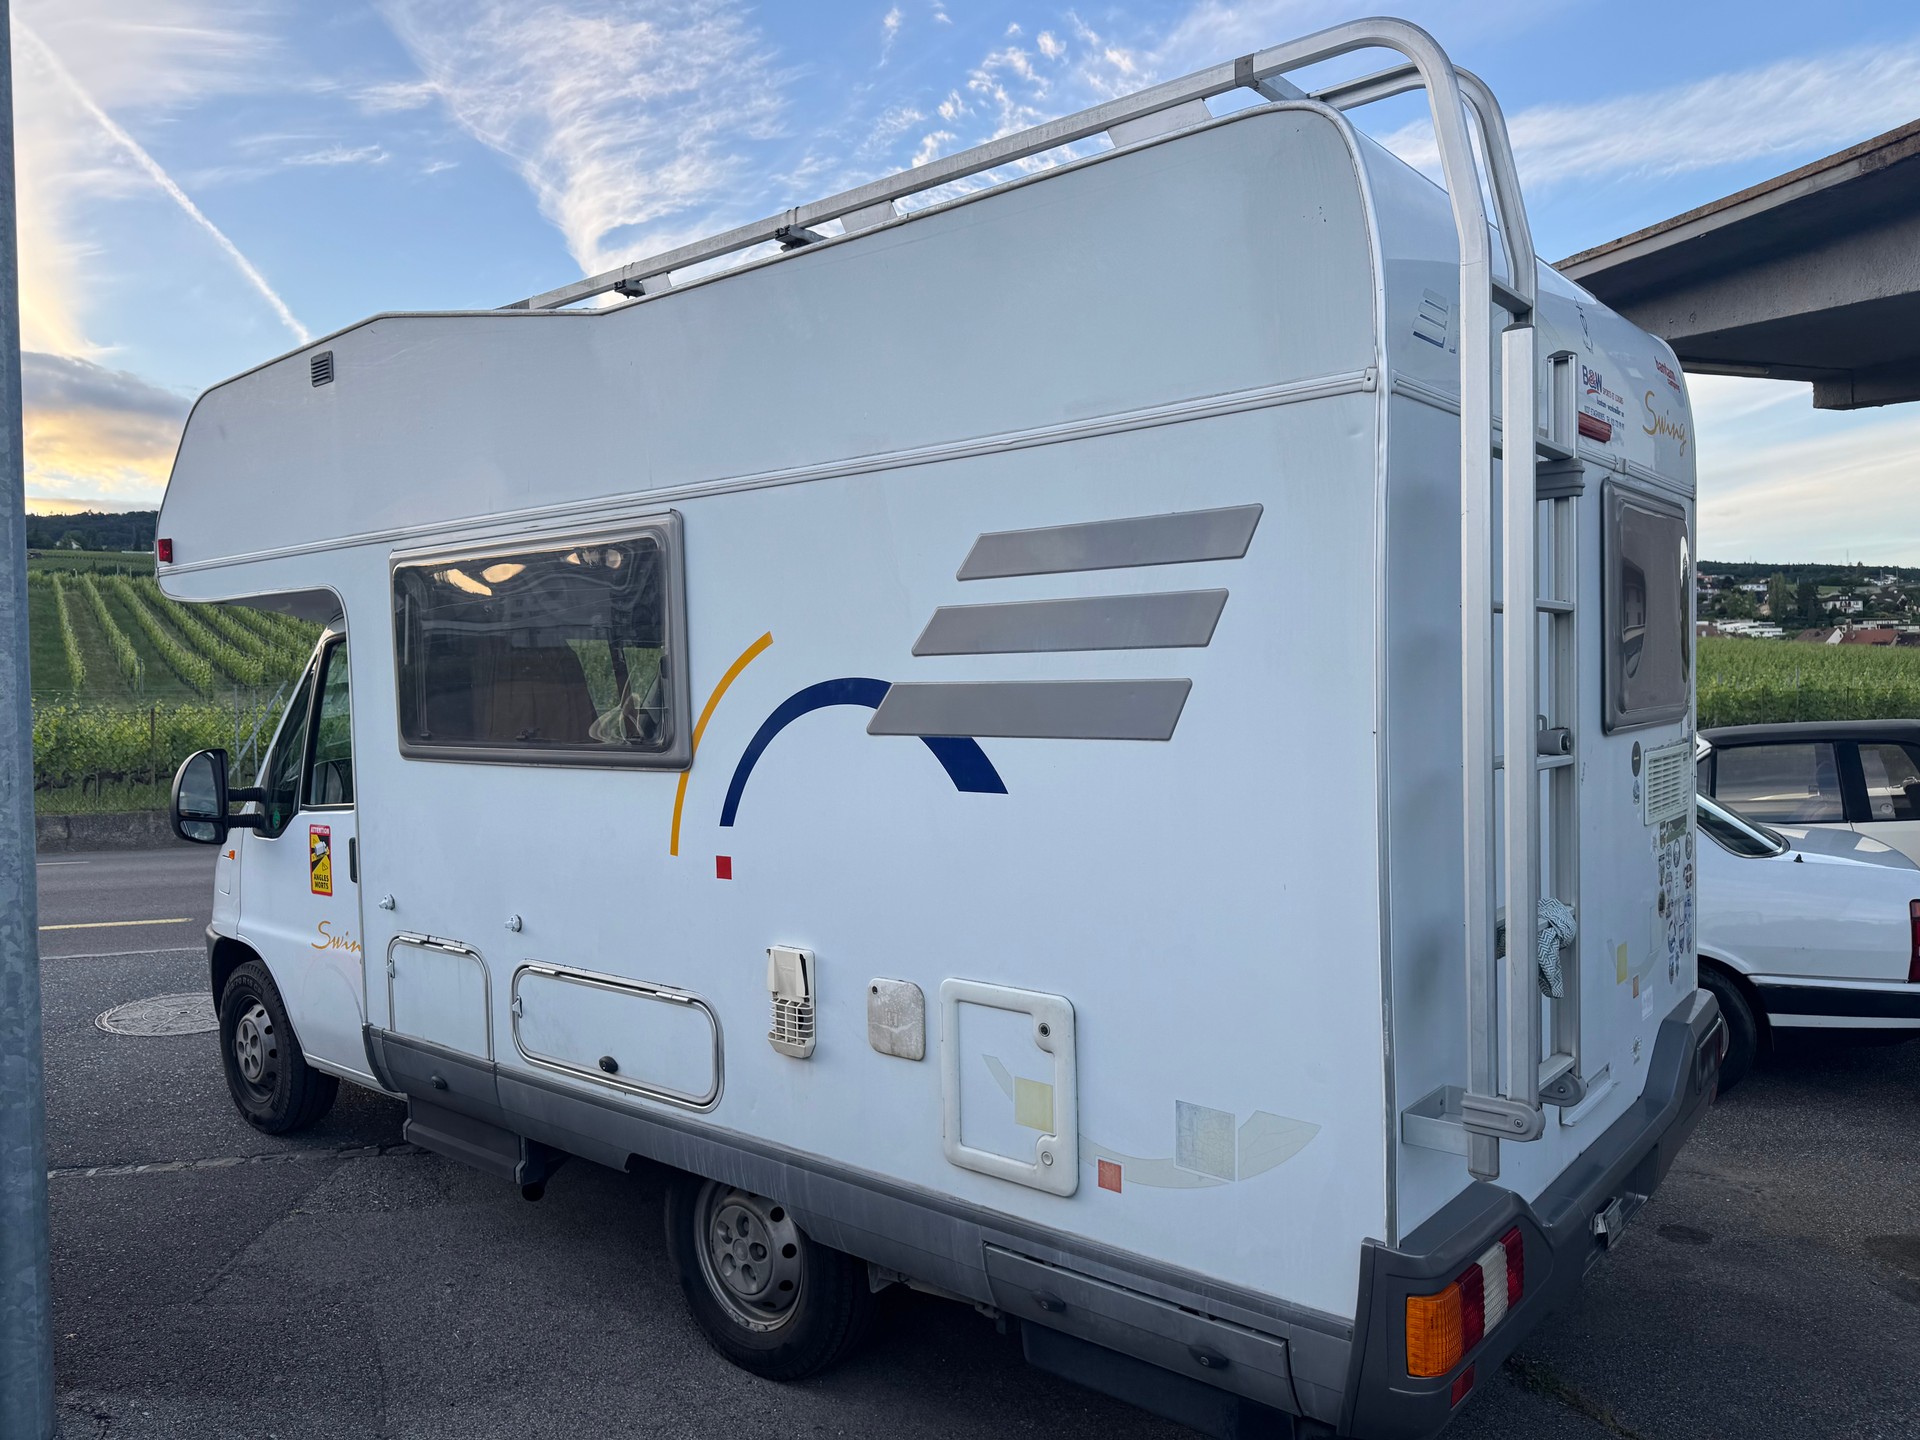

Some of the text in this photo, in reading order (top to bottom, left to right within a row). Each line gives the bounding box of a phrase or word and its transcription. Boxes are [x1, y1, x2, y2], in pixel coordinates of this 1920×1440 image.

[1642, 390, 1687, 457] Swing
[310, 827, 330, 835] ATTENTION
[313, 873, 329, 882] ANGLES
[314, 881, 329, 890] MORTS
[311, 920, 362, 953] Swin
